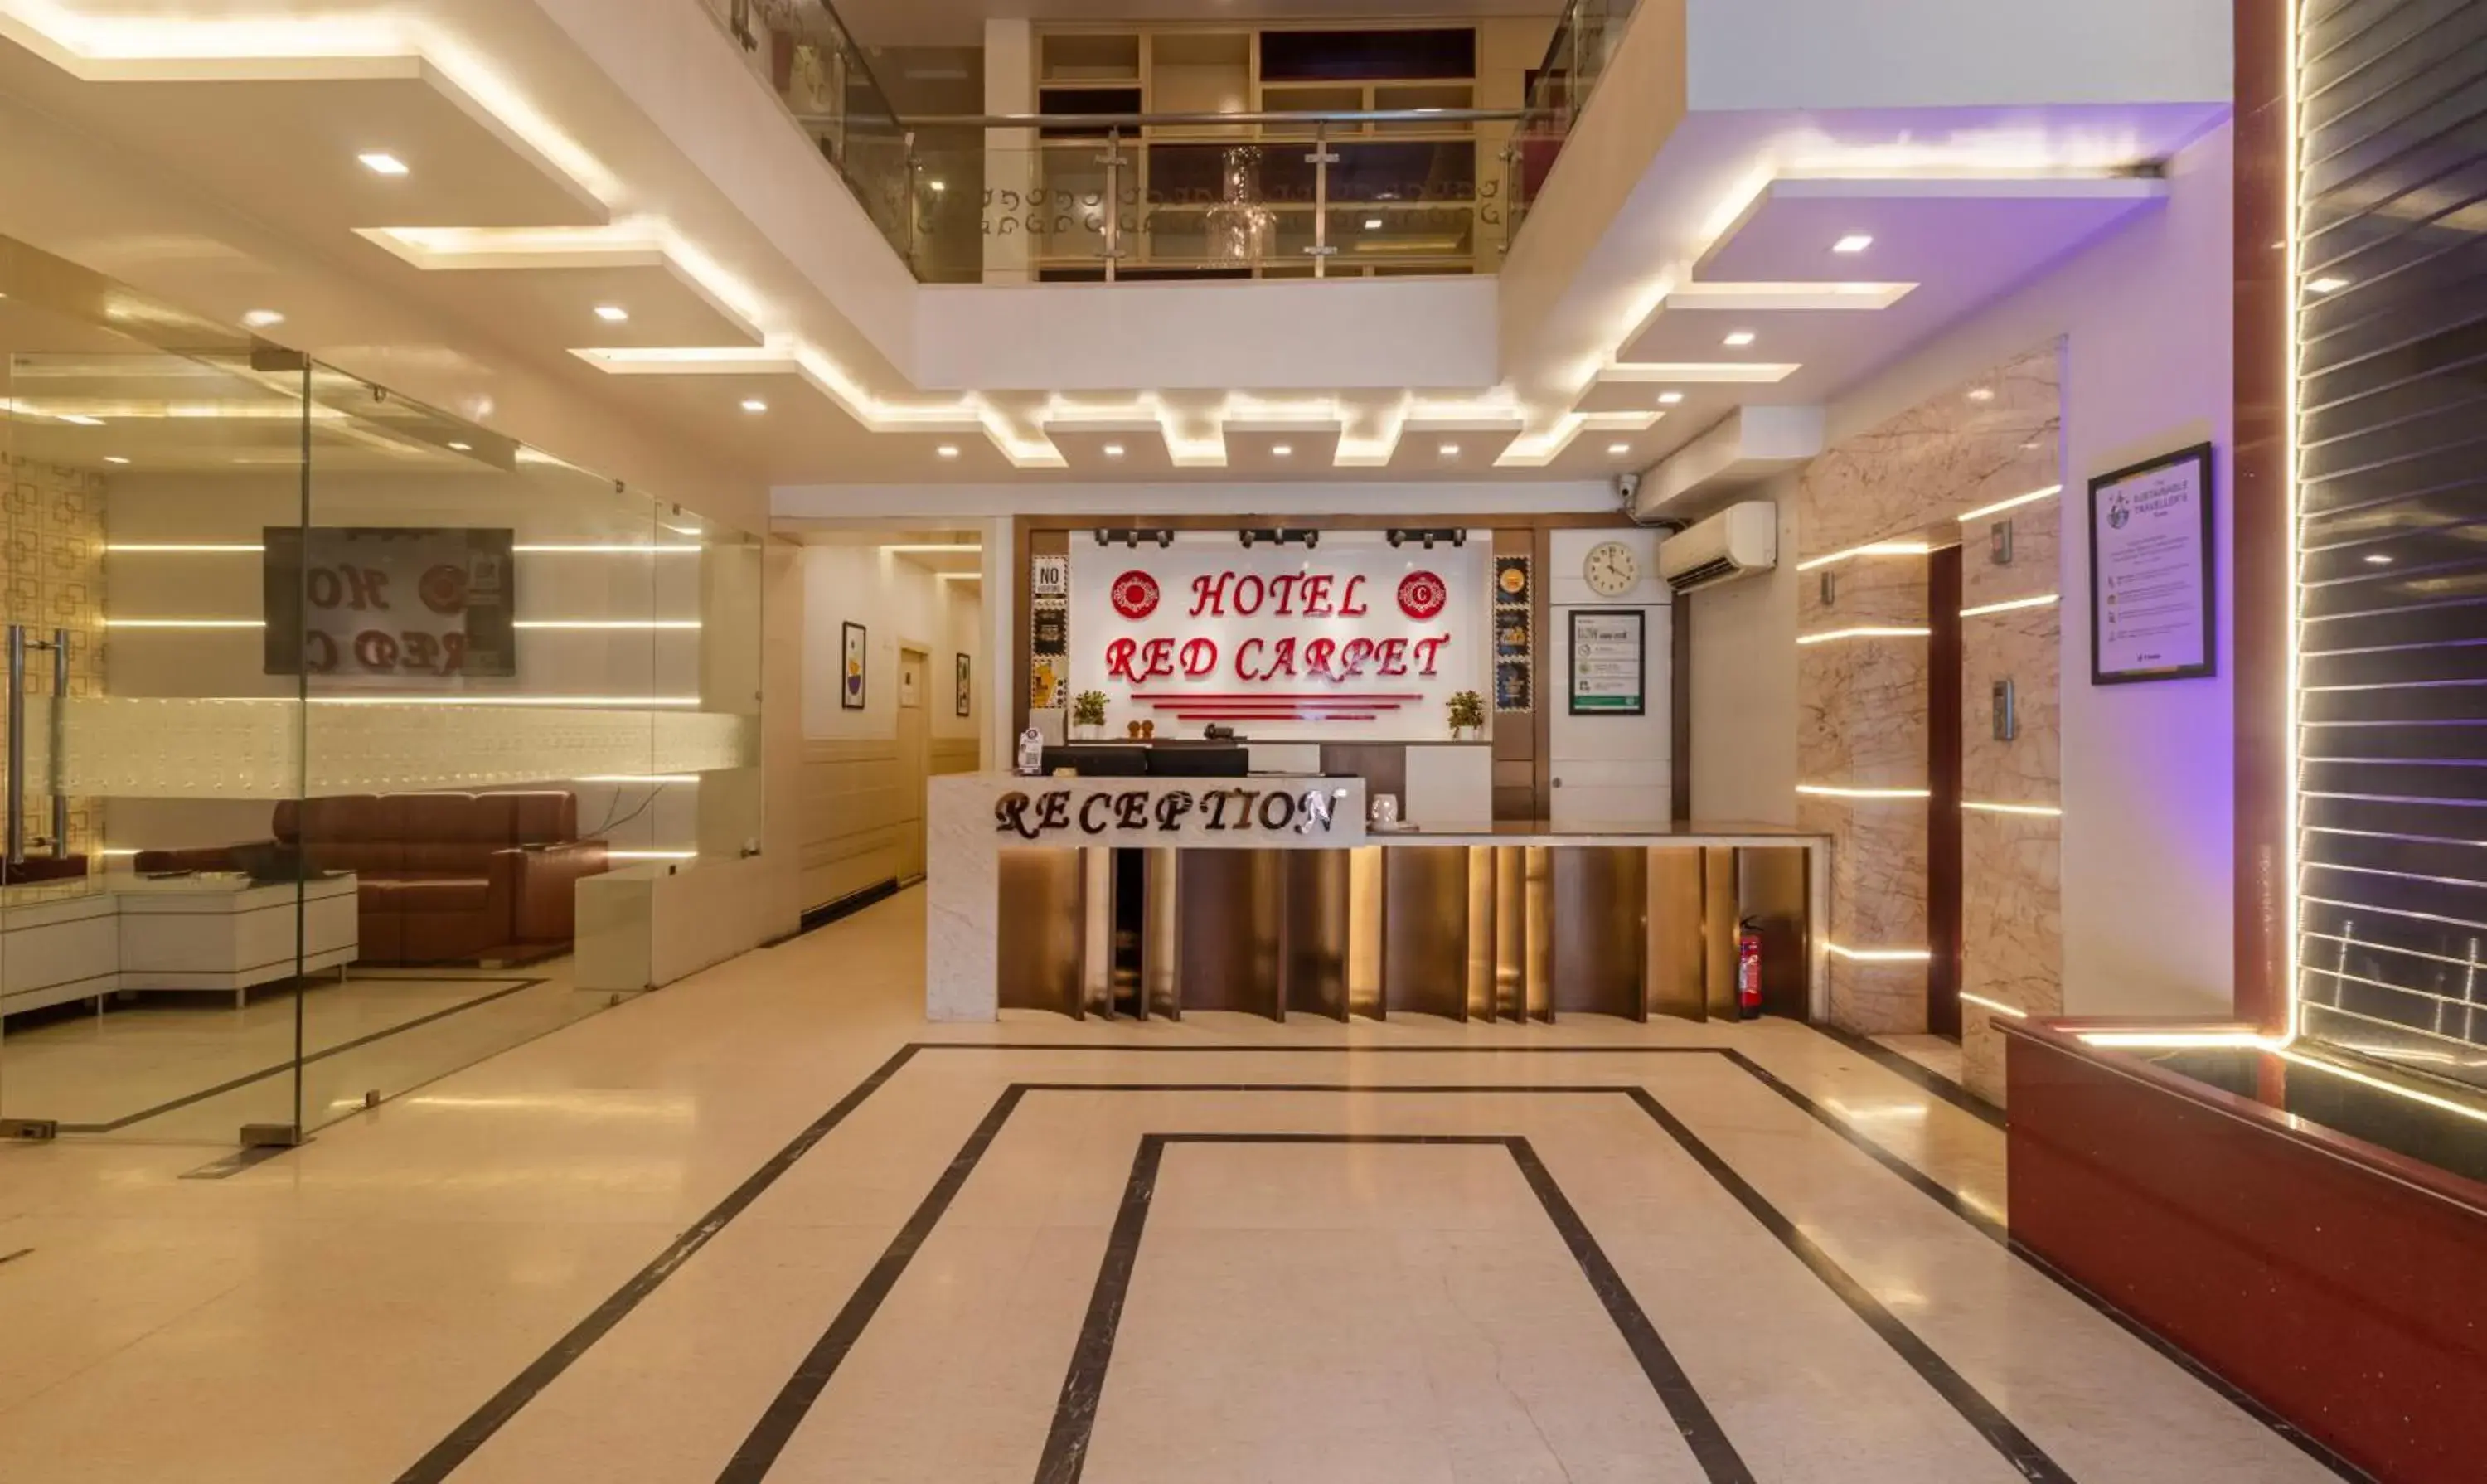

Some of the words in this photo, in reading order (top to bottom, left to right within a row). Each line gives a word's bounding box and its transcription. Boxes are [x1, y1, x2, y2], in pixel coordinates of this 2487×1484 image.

[1040, 567, 1059, 584] NO
[1189, 570, 1368, 617] HOTEL
[1105, 637, 1219, 685] RED
[1234, 633, 1451, 683] CARPET
[995, 788, 1347, 840] RECEPTION
